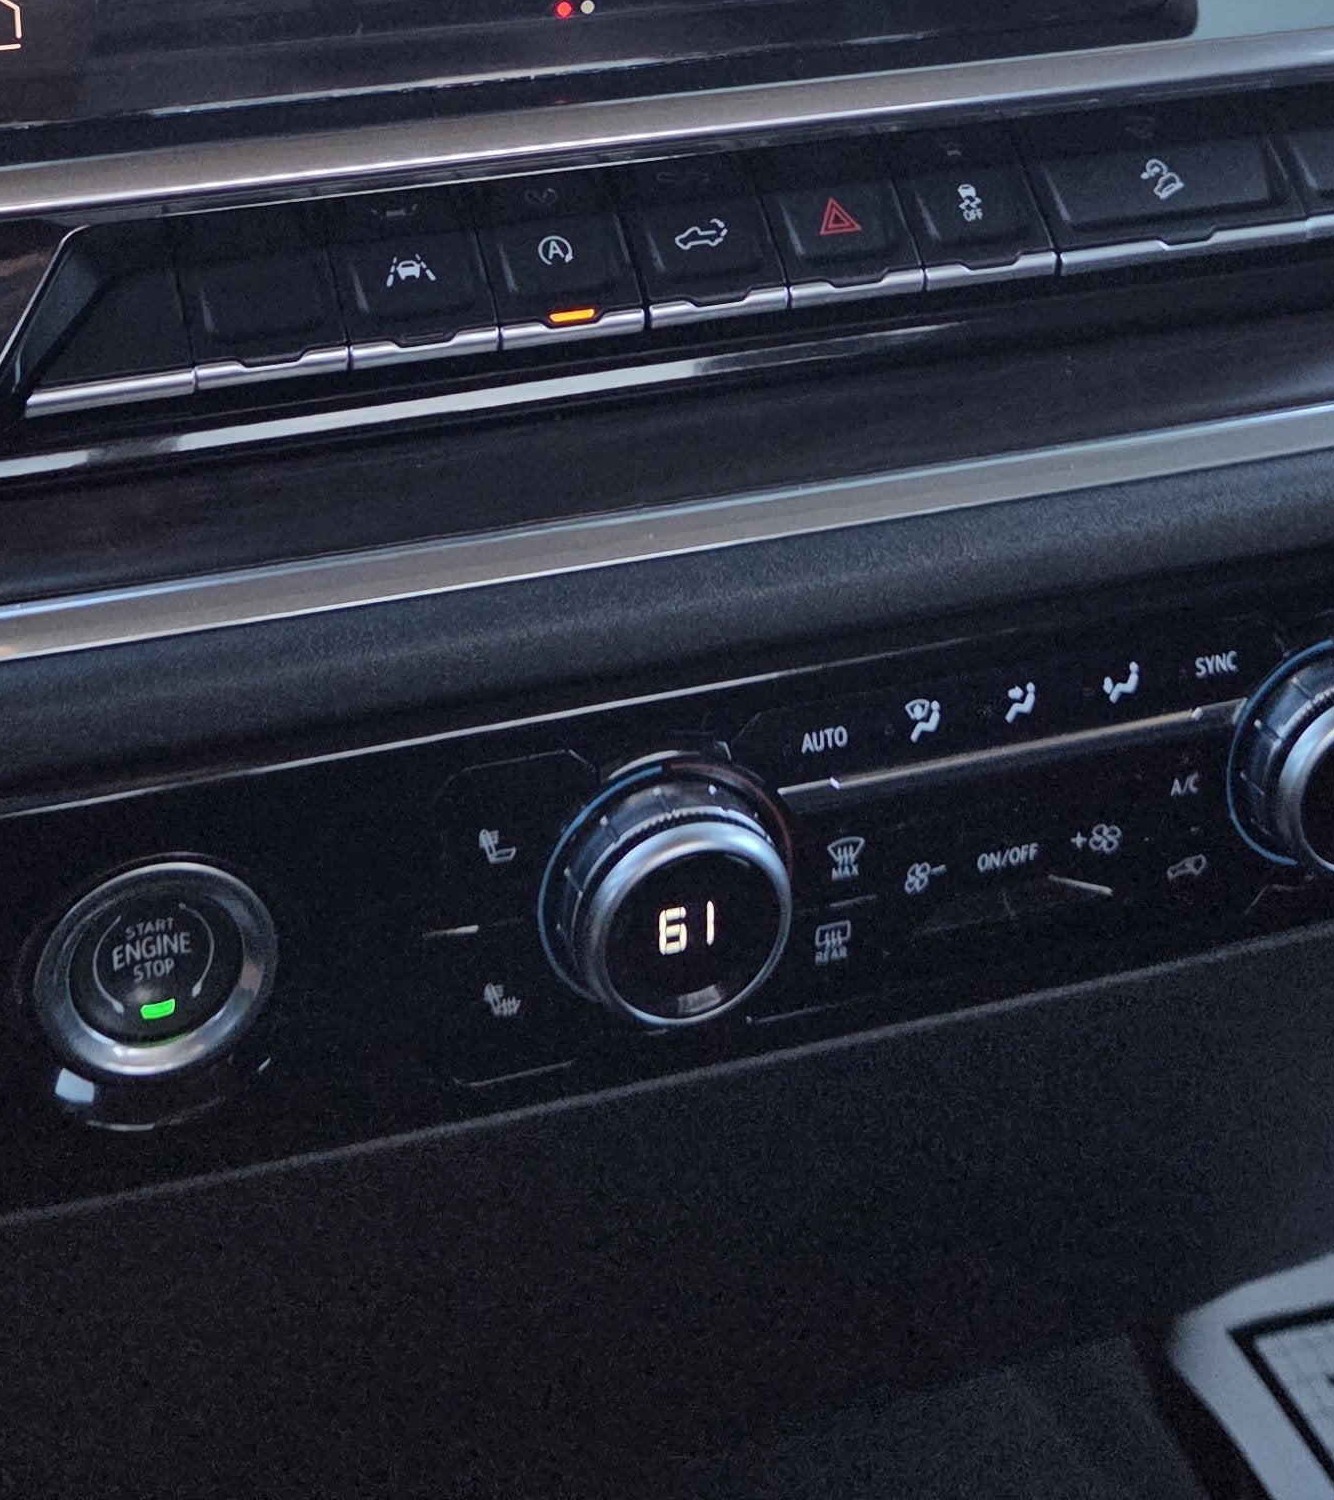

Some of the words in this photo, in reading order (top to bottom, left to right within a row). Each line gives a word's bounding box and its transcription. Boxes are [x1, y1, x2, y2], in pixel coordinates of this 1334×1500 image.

[548, 240, 565, 260] A
[1195, 651, 1238, 678] SYNC
[801, 726, 848, 754] AUTO
[1170, 771, 1199, 797] A/C
[977, 843, 1039, 873] ON/OFF
[832, 864, 859, 881] MAX
[125, 917, 174, 940] START
[657, 900, 716, 955] 61
[112, 931, 192, 972] ENGINE
[133, 958, 176, 983] STOP
